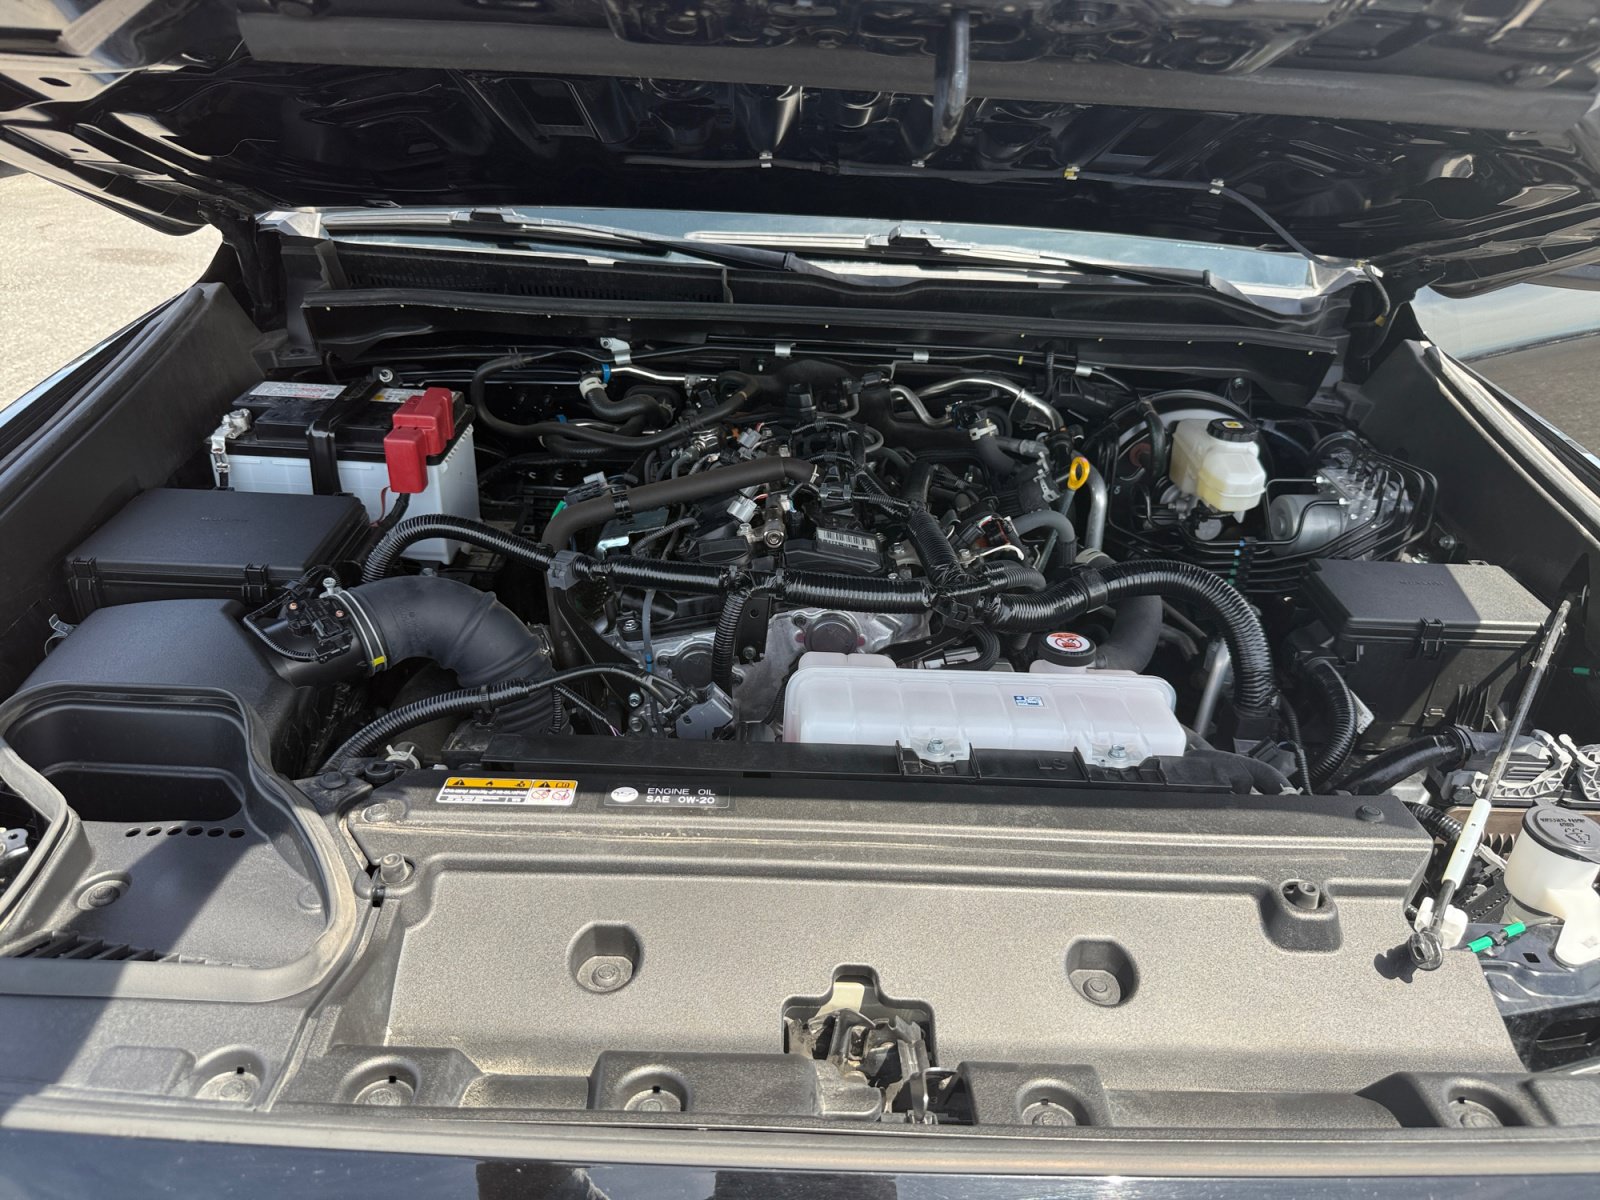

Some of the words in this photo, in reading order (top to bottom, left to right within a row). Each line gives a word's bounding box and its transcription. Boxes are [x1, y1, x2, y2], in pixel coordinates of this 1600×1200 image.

[646, 787, 690, 796] ENGINE
[697, 788, 716, 796] OIL
[645, 795, 671, 804] SAE
[677, 796, 715, 804] 0W-20
